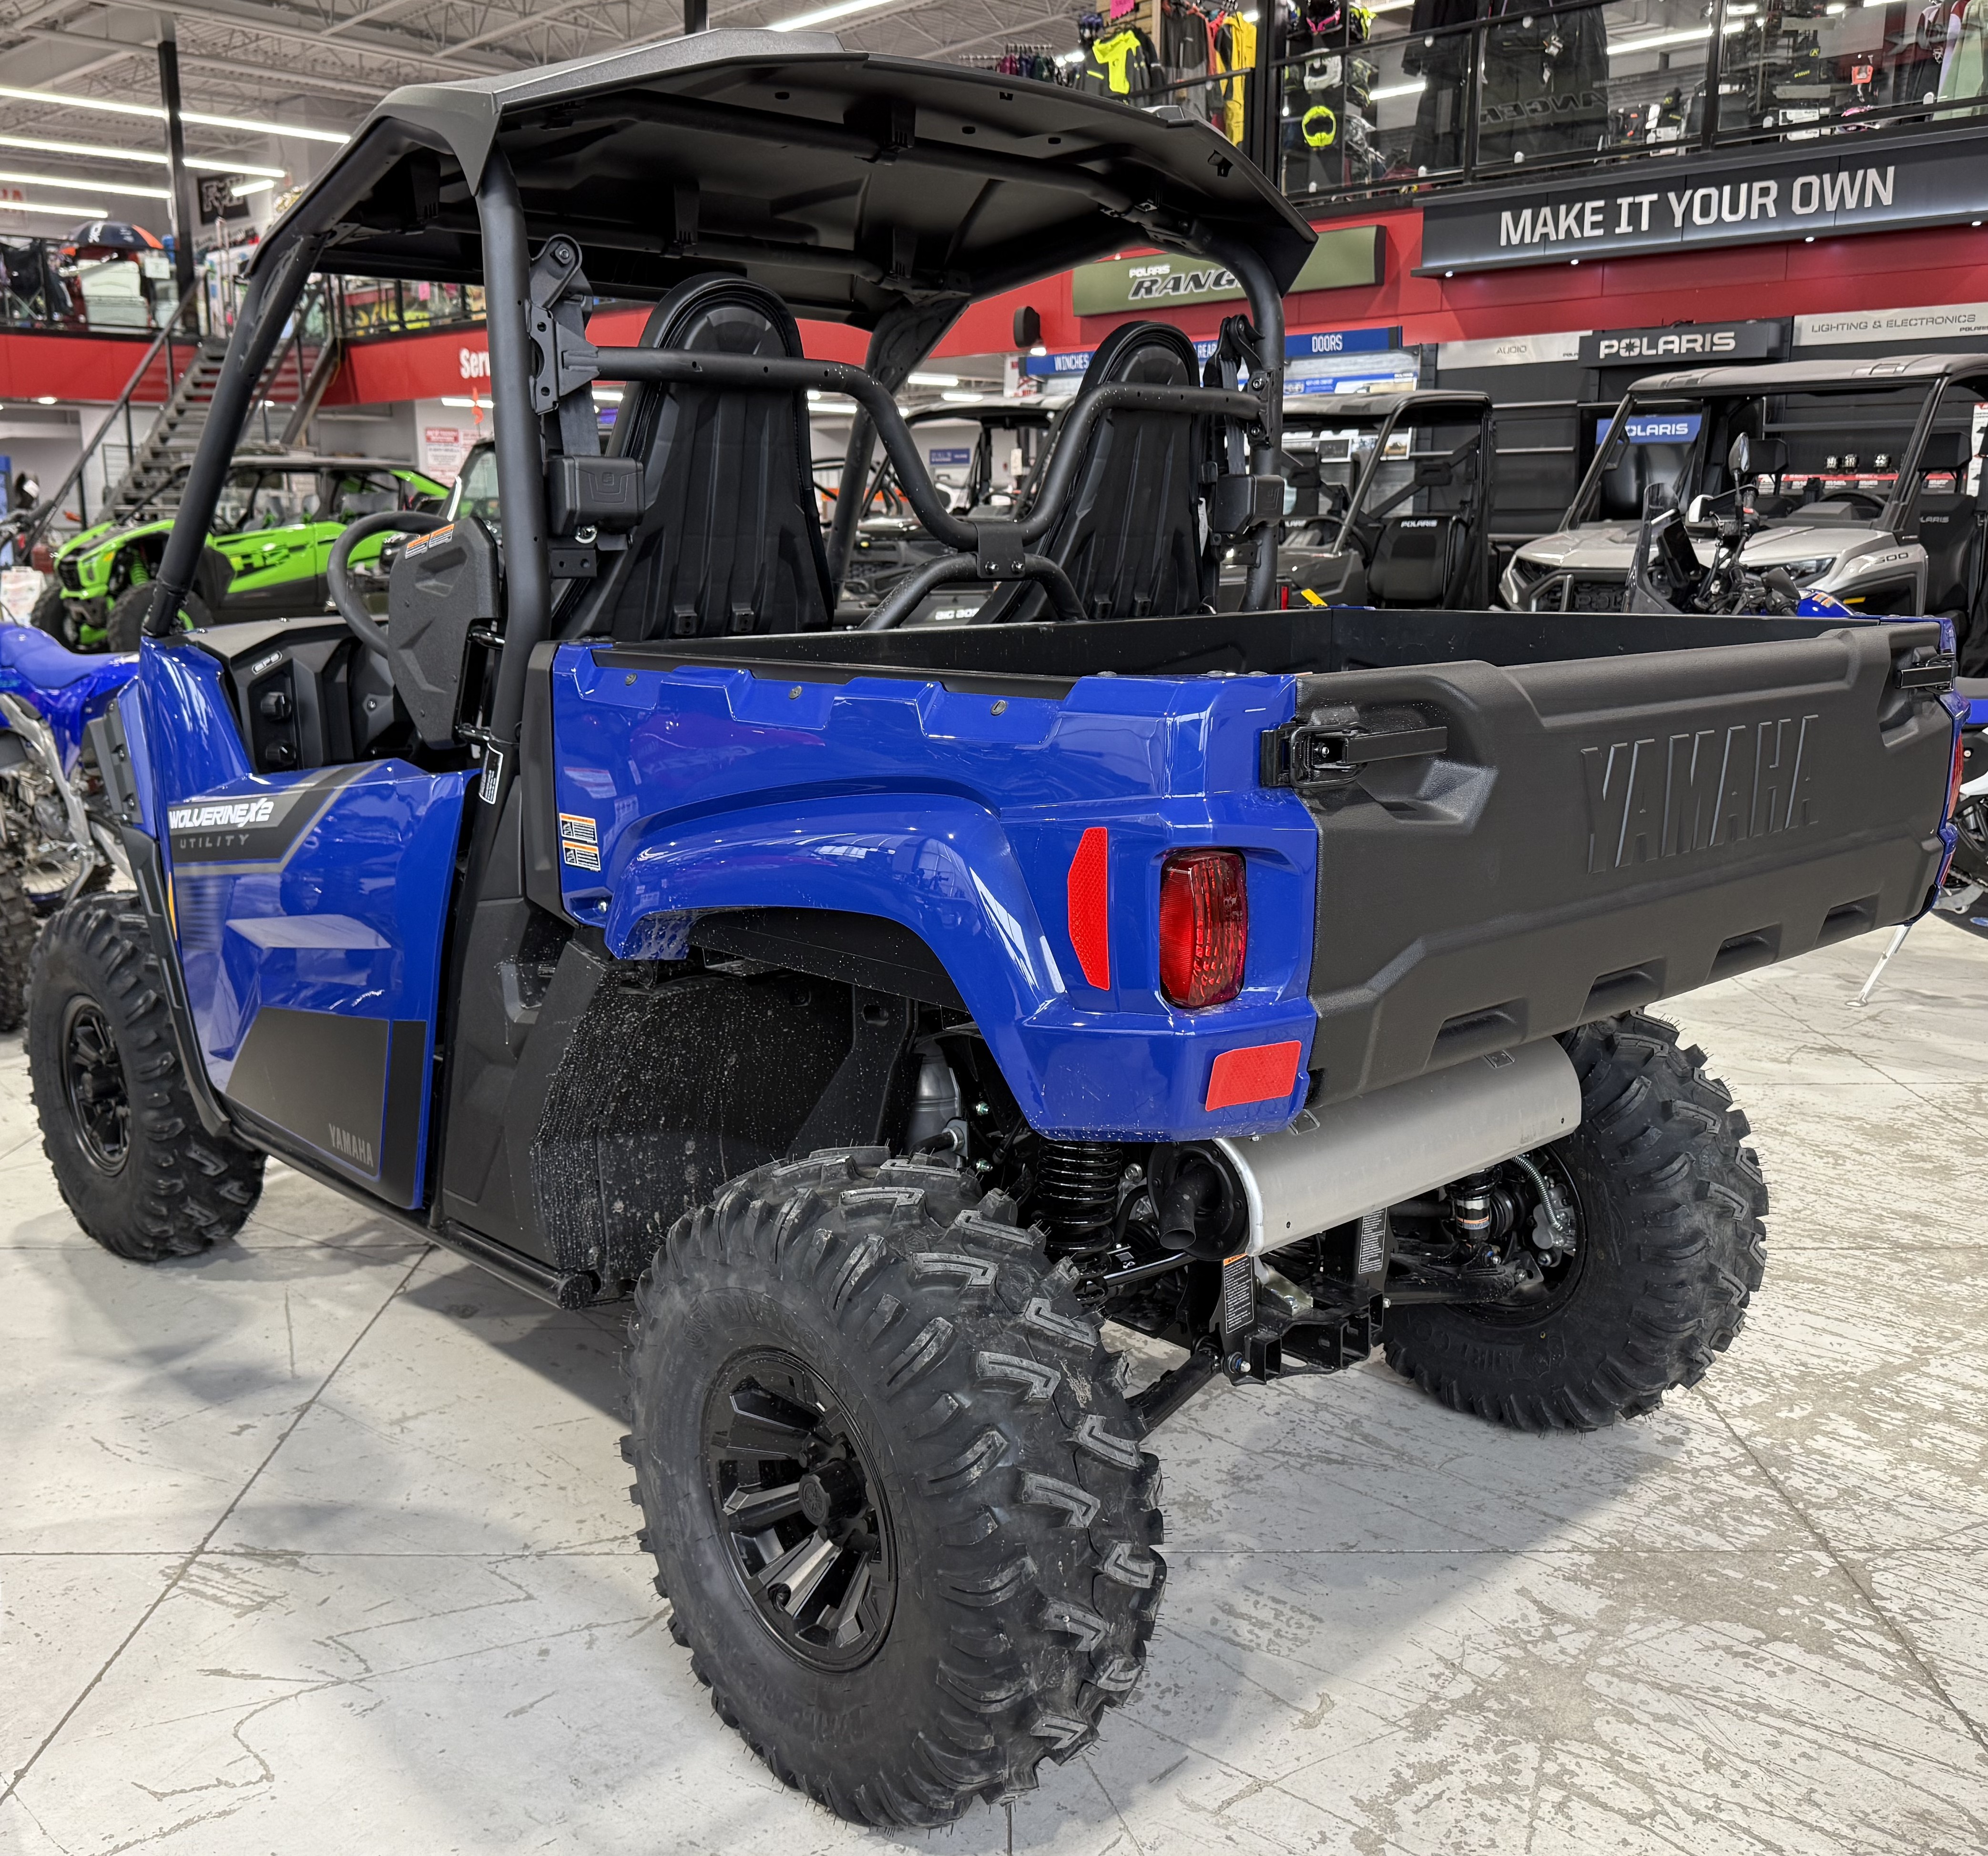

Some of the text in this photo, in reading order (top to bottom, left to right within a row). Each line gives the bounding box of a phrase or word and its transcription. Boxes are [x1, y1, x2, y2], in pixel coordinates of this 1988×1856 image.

[1499, 166, 1896, 246] MAKE IT YOUR OWN
[1129, 264, 1170, 278] POLARIS
[1128, 268, 1241, 300] RANG
[1811, 314, 1976, 333] LIGHTING & ELECTRONICS
[1312, 335, 1343, 353] DOORS
[1496, 345, 1527, 355] AUDIO
[1599, 331, 1736, 359] POLARIS
[1054, 354, 1090, 371] WINCHES
[1624, 423, 1689, 436] OLARIS
[1580, 714, 1819, 875] YAMAHA
[180, 834, 250, 849] UTILITY
[328, 1122, 374, 1168] YAMAHA
